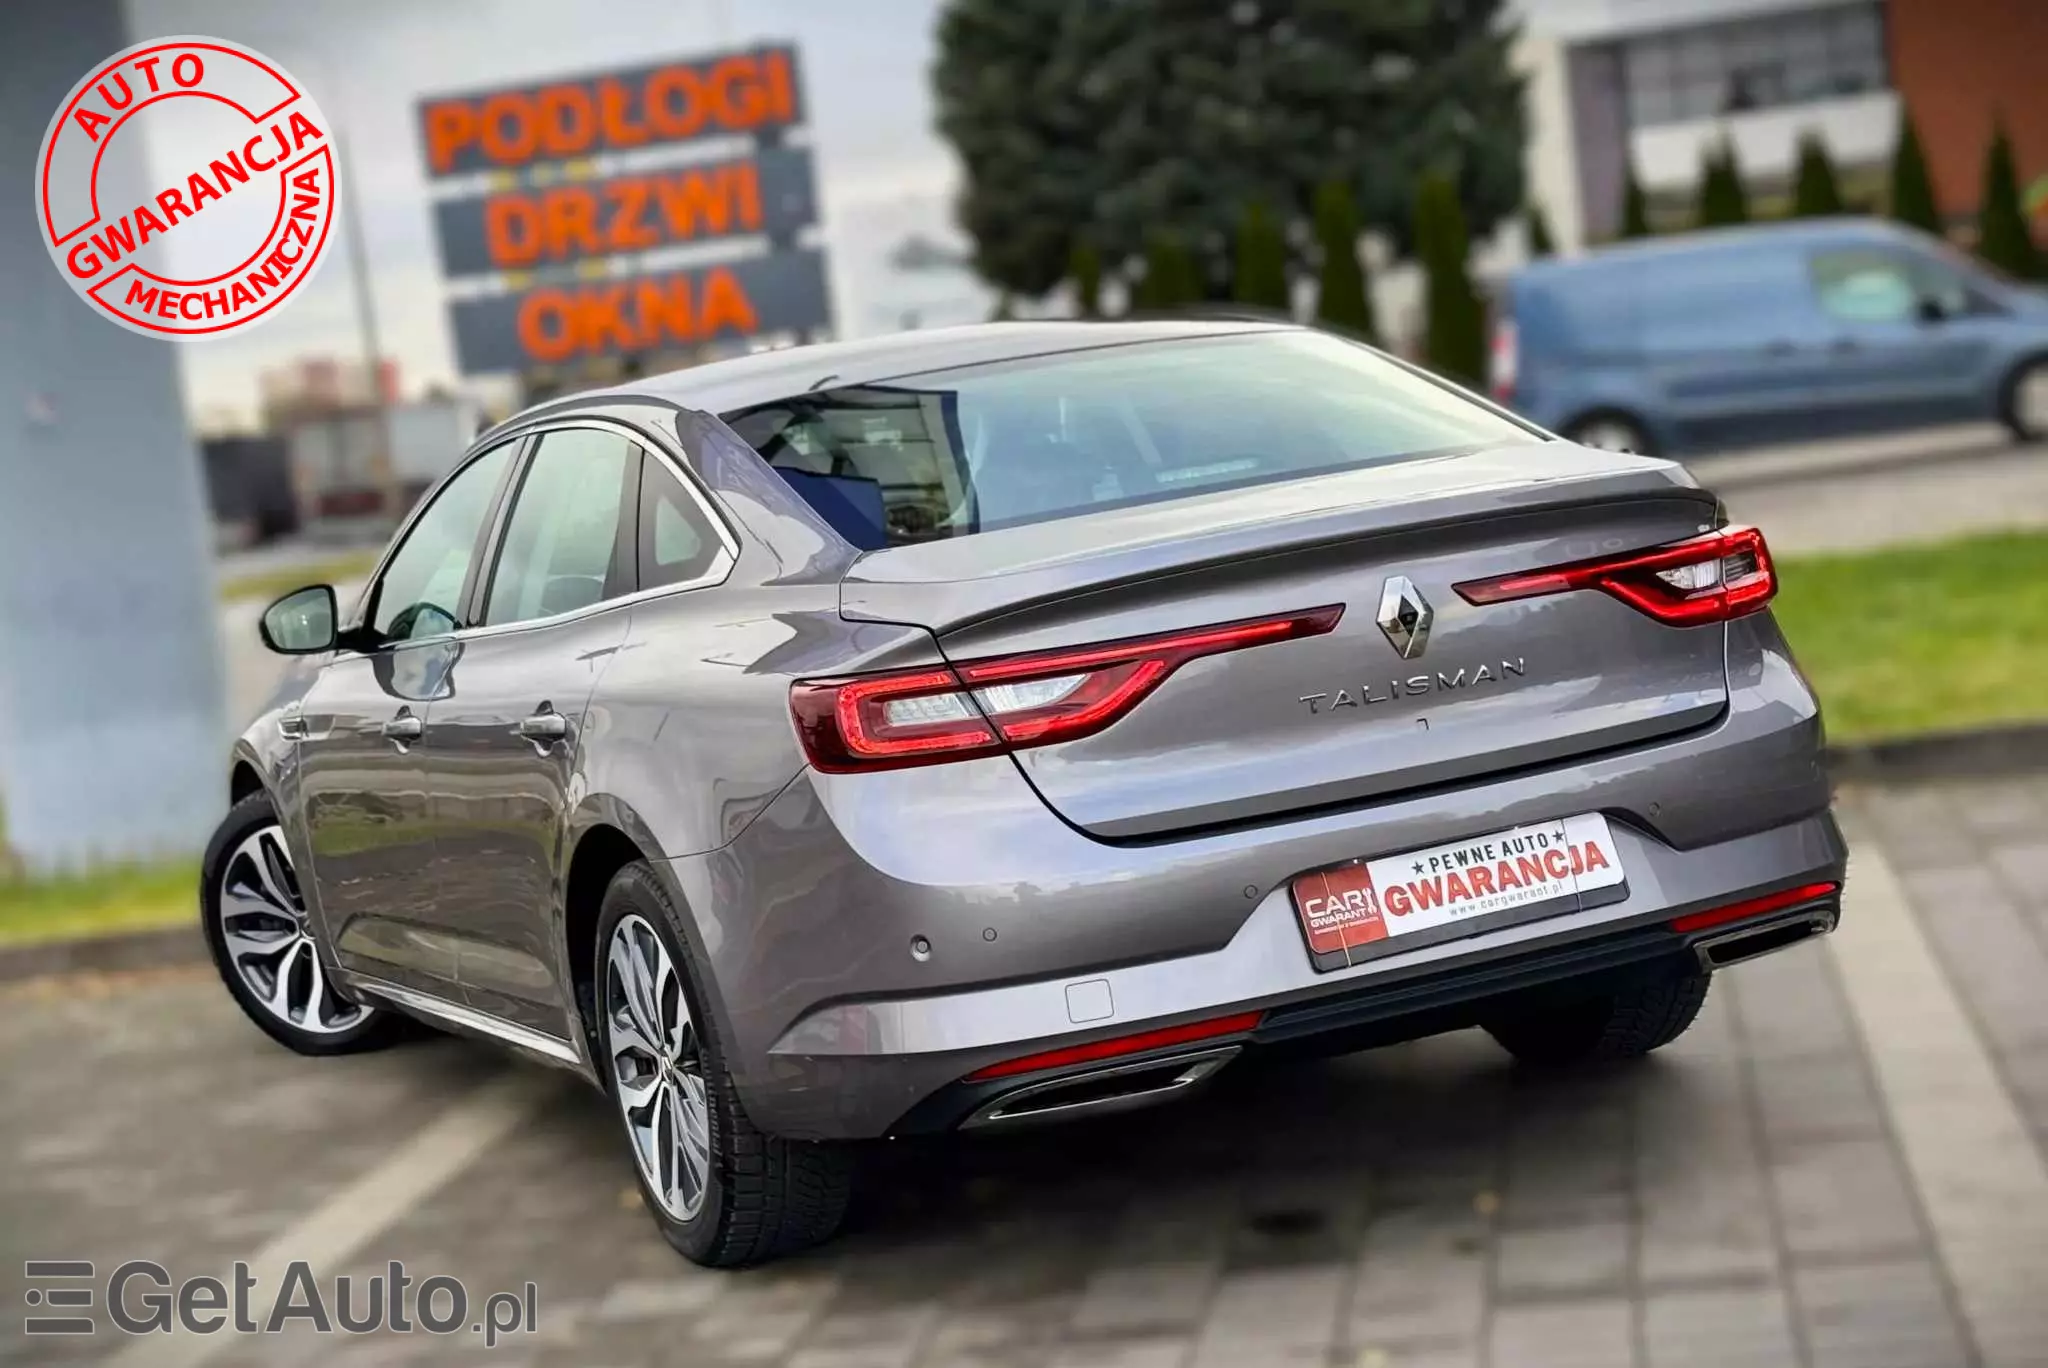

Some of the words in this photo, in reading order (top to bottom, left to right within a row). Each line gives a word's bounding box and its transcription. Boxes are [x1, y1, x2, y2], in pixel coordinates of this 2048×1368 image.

[485, 160, 763, 266] DRZWI
[518, 264, 758, 362] OKNA
[1299, 657, 1525, 714] TALISMAN
[1383, 841, 1610, 917] GWARANCJA
[1429, 844, 1496, 873] PEWNE
[1502, 833, 1549, 857] AUTO
